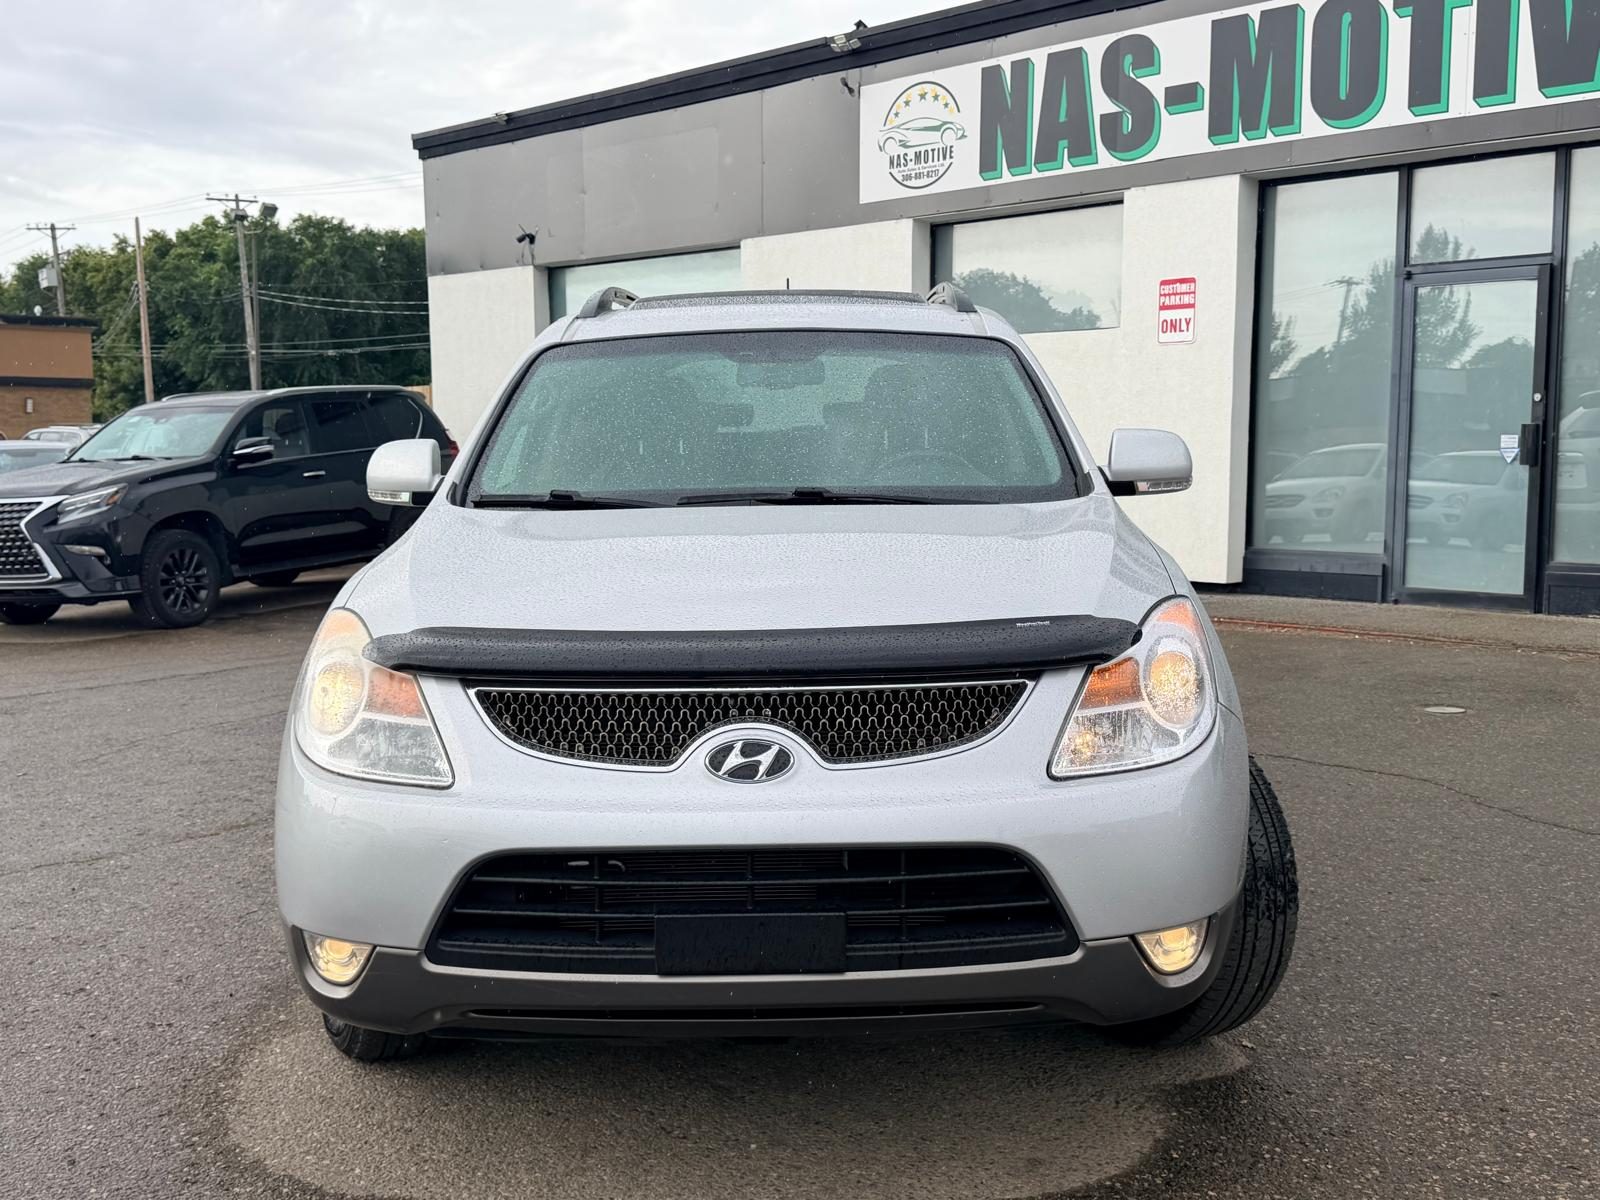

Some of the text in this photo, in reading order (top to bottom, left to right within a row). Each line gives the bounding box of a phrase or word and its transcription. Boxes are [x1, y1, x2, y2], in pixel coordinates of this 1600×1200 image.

[889, 145, 954, 170] NAS-MOTIVE
[1160, 282, 1195, 295] CUSTOMER
[1160, 294, 1195, 306] PARKING
[1161, 317, 1192, 334] ONLY
